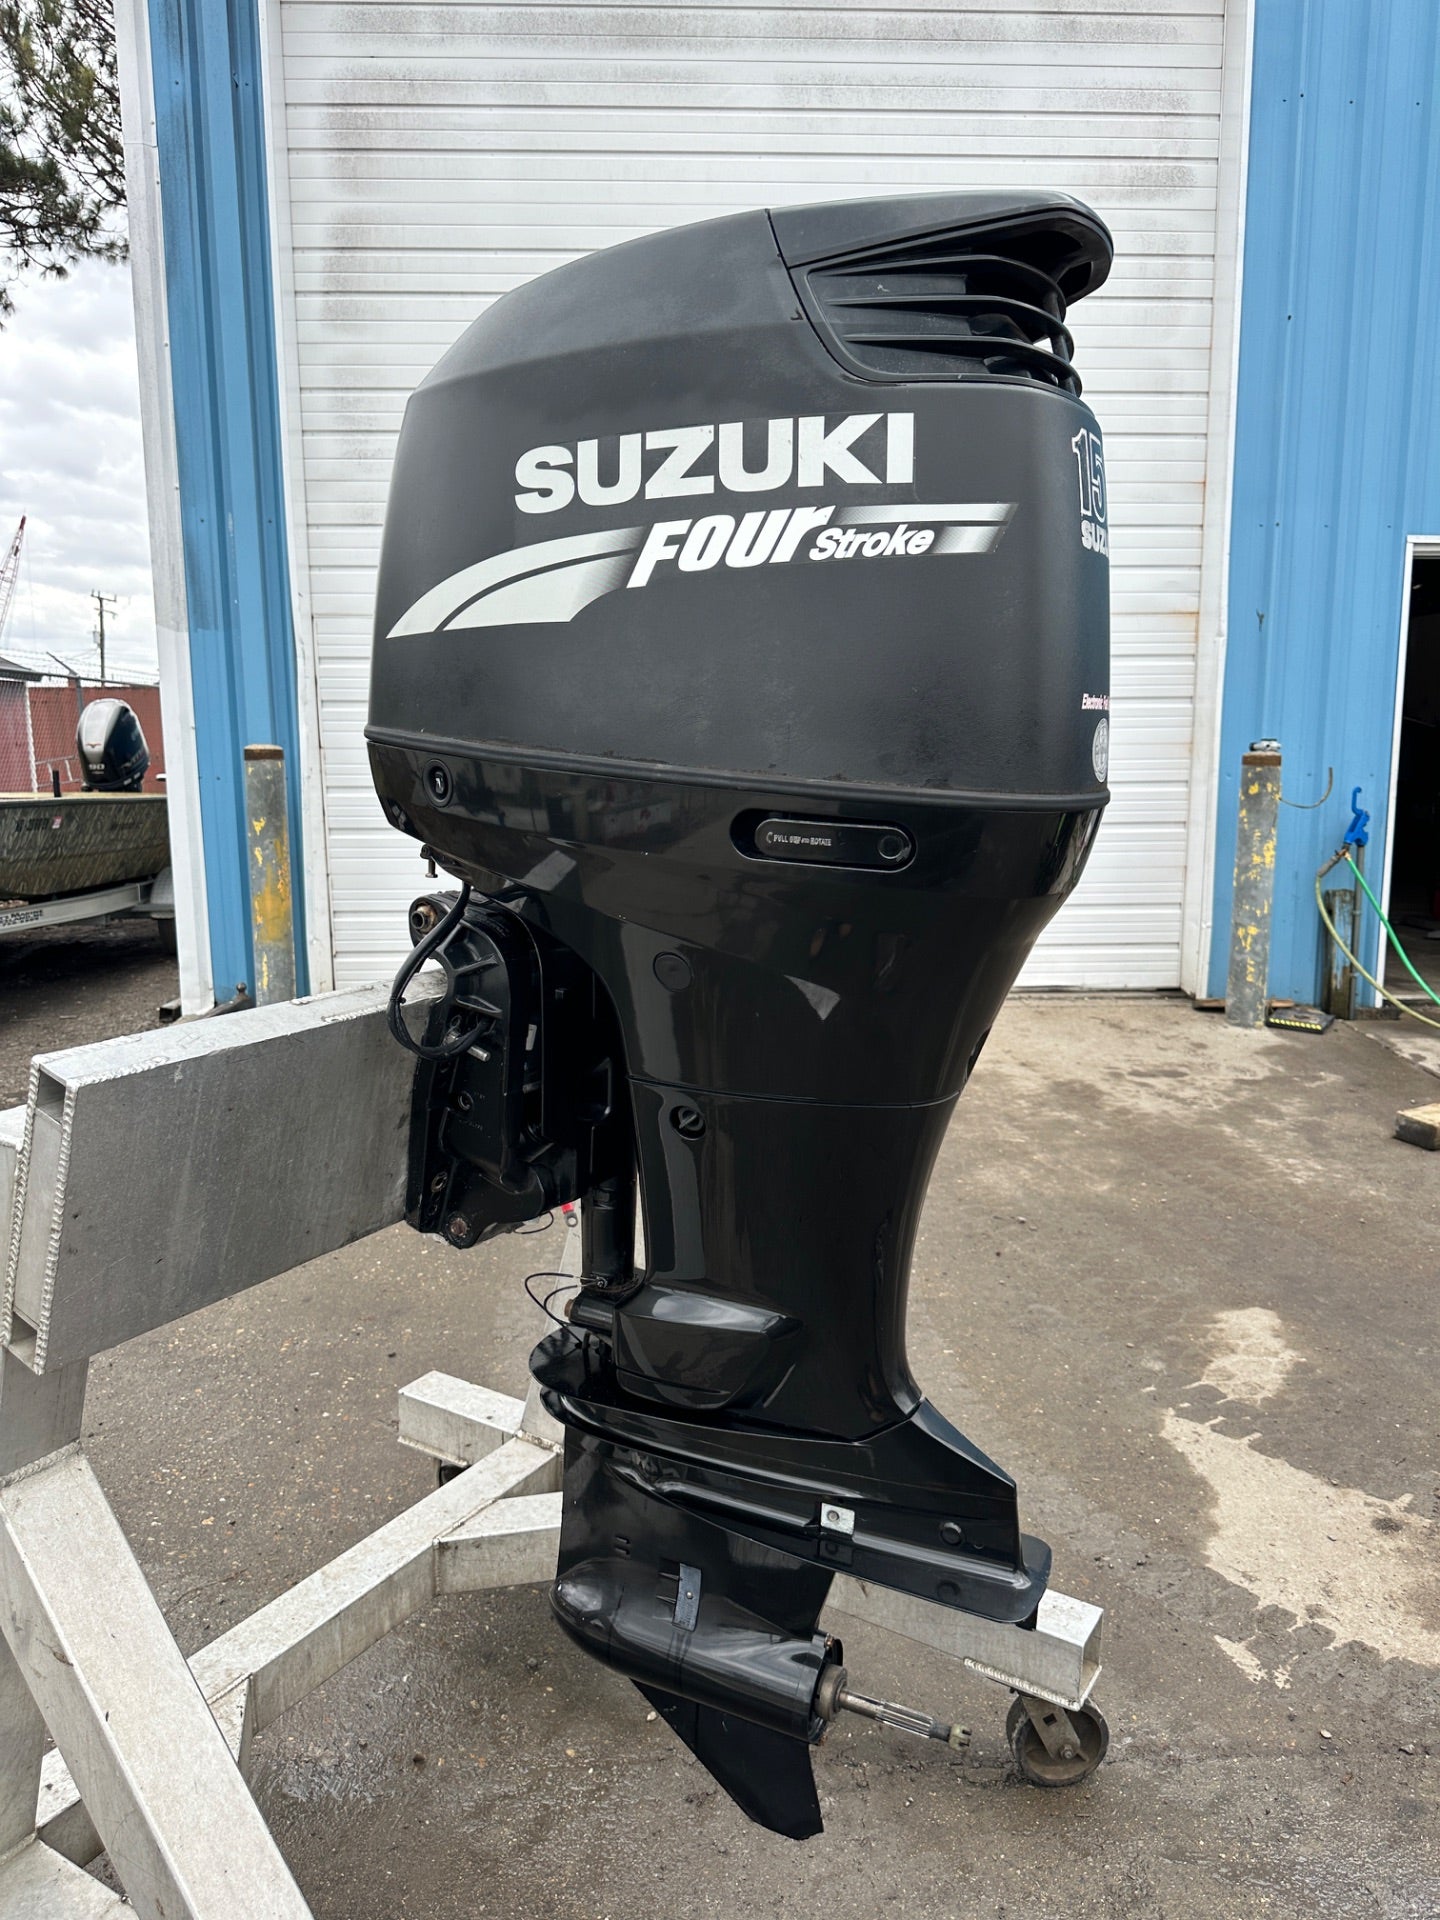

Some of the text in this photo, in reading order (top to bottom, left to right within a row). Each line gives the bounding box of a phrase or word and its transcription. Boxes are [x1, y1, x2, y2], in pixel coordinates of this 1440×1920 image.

[515, 412, 915, 514] SUZUKI
[808, 524, 935, 561] Stroke
[773, 834, 788, 843] PULL
